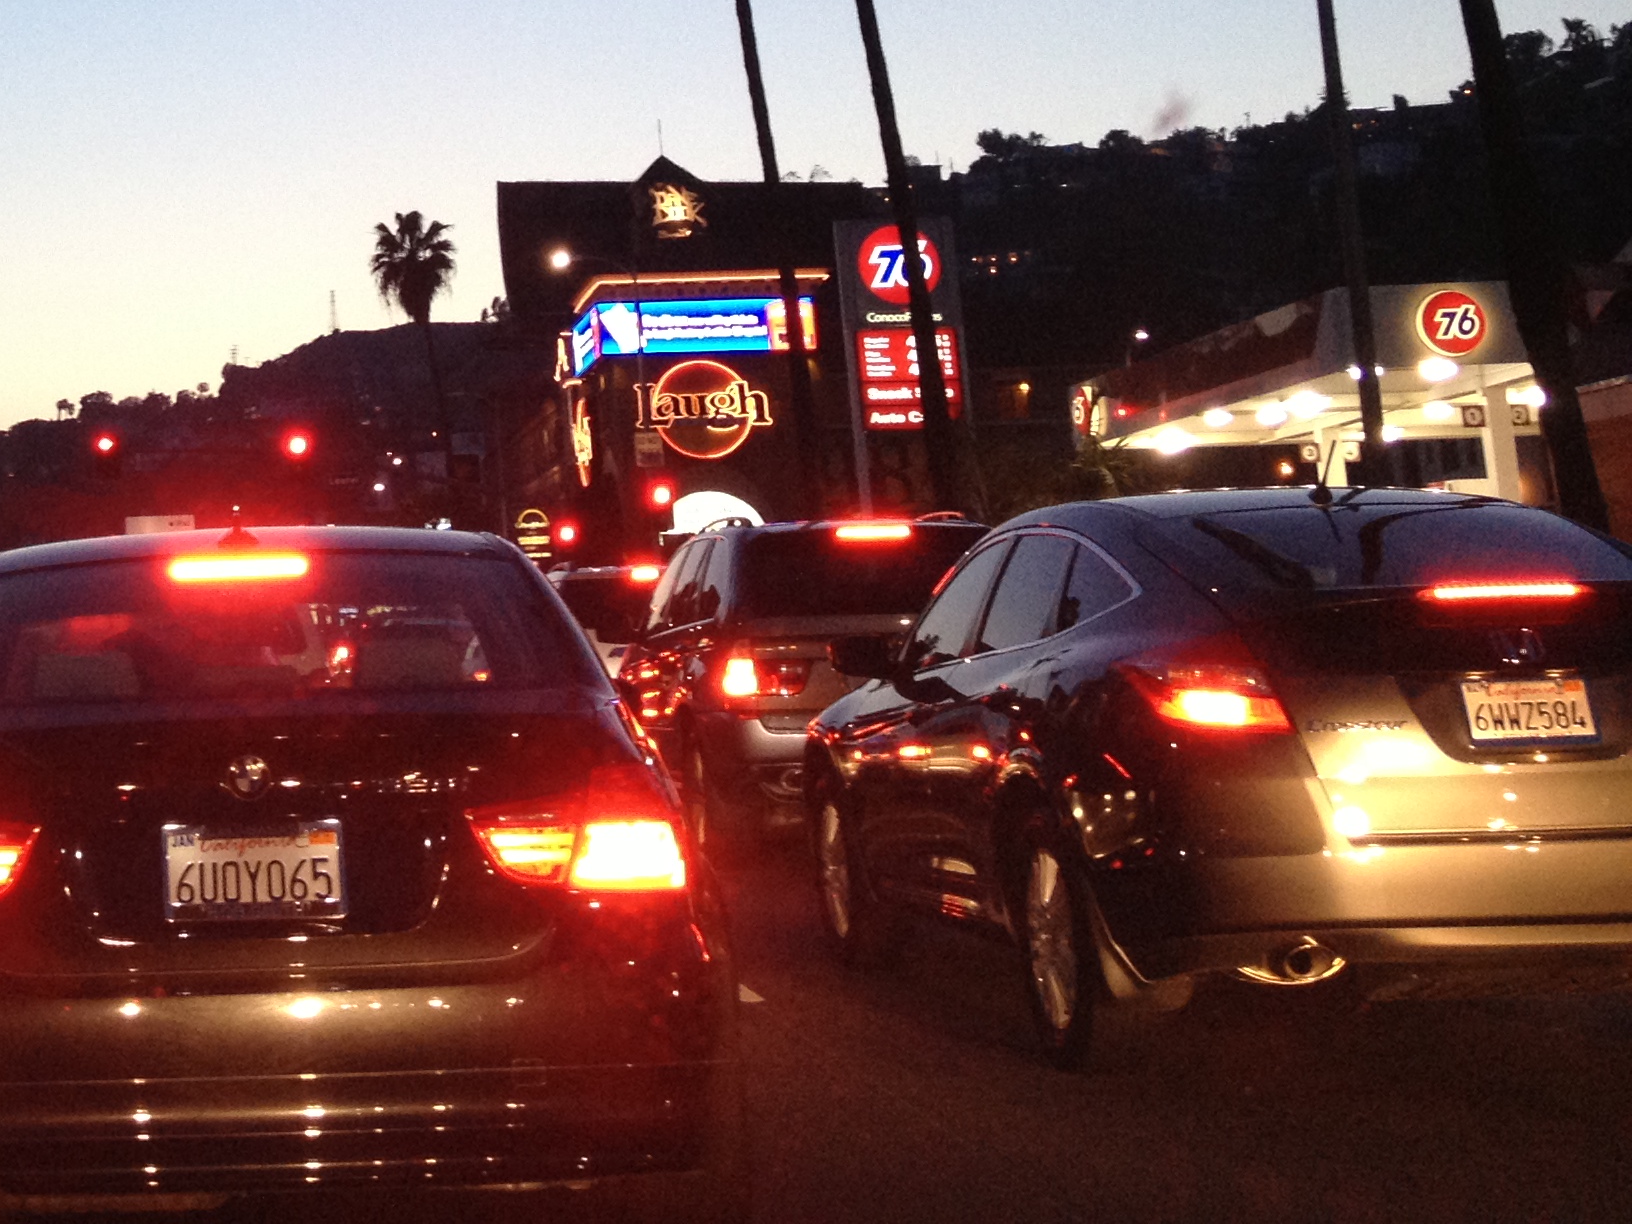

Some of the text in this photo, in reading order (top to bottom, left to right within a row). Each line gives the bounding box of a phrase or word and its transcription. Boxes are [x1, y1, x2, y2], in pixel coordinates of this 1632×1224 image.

[1434, 304, 1481, 339] 76
[633, 381, 773, 432] Laugh
[1475, 701, 1587, 732] 6WWZ584
